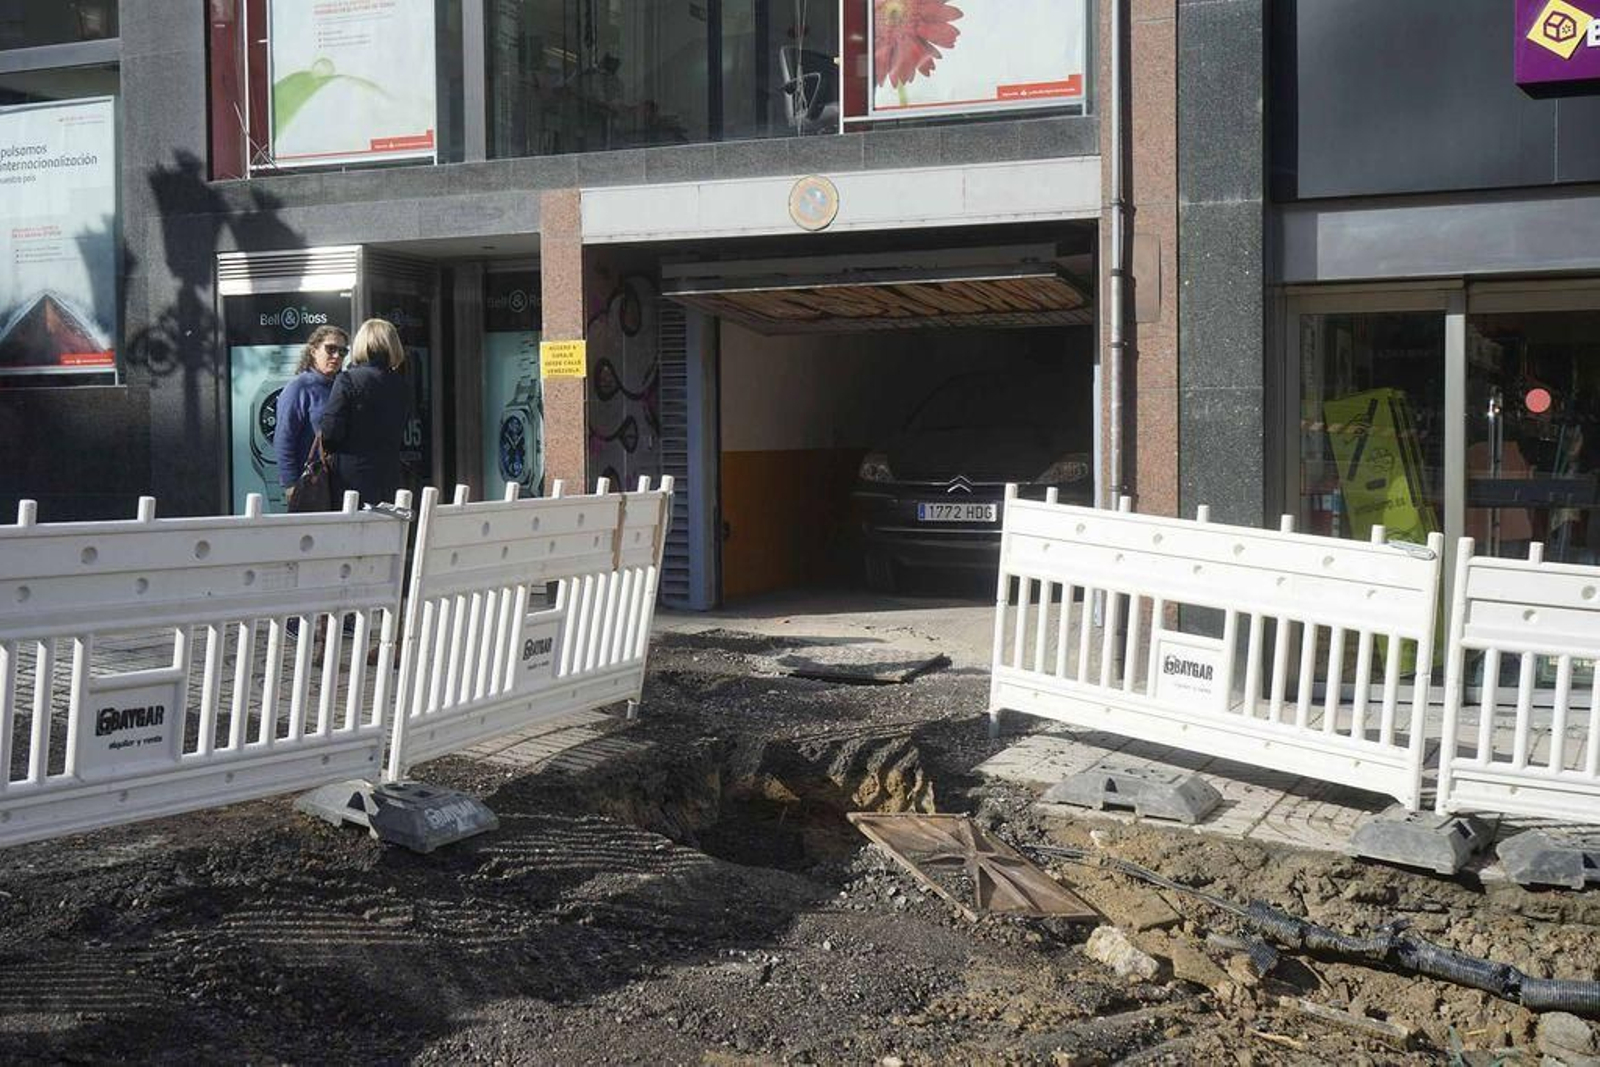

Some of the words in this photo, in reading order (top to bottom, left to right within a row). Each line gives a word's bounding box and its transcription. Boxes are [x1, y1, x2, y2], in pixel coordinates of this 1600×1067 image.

[260, 313, 280, 326] Bell
[301, 313, 328, 324] Ross
[929, 505, 962, 519] 1772
[967, 505, 993, 519] HDG
[1174, 658, 1213, 680] BAYGAR
[111, 705, 164, 730] BAYGAR
